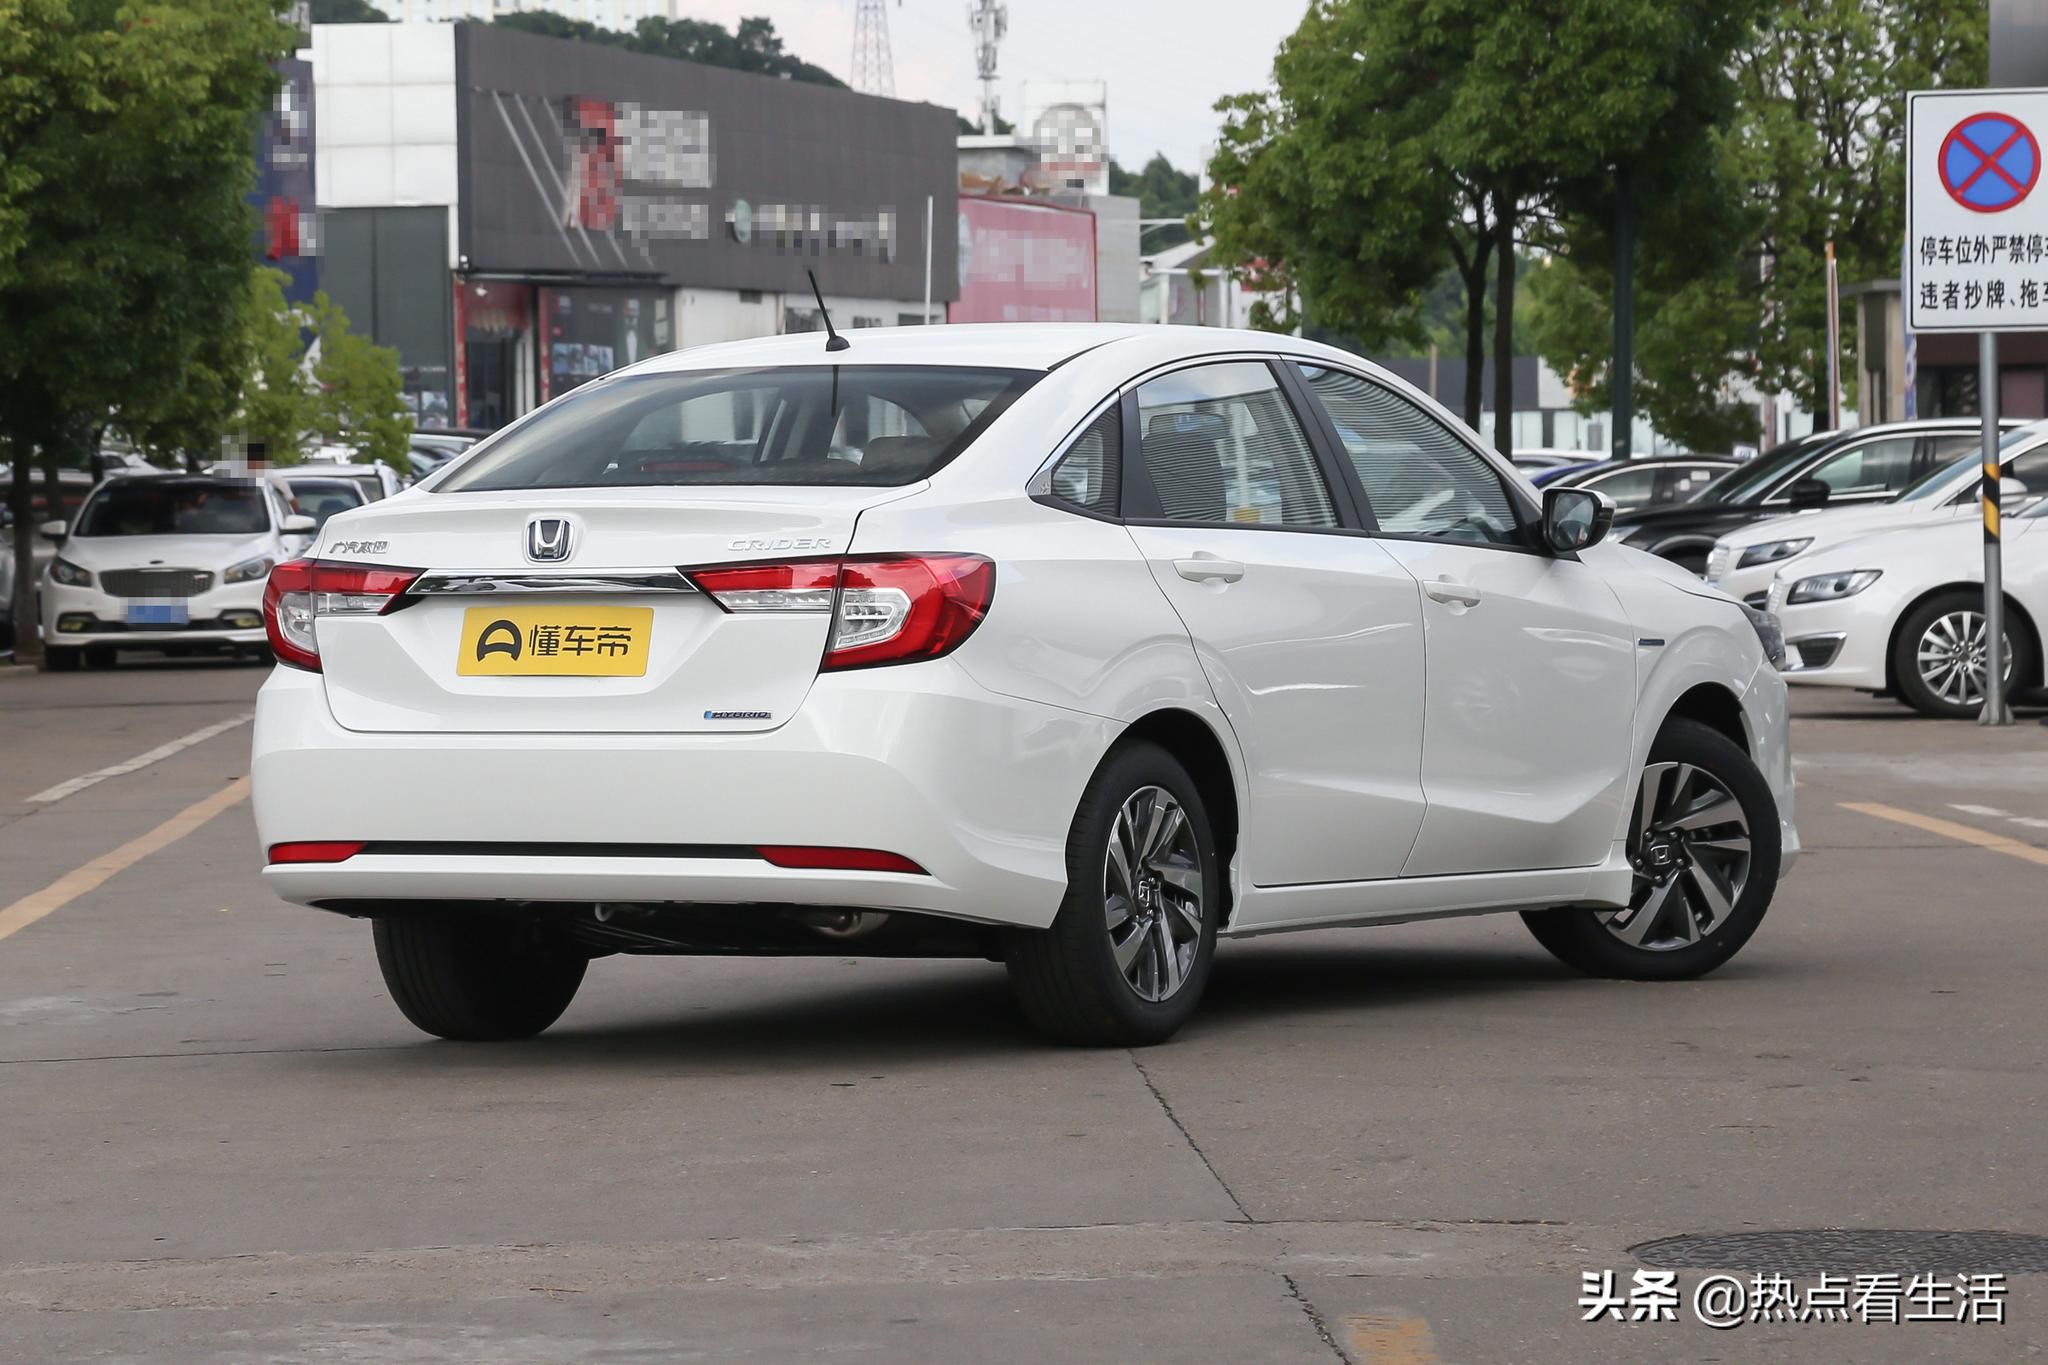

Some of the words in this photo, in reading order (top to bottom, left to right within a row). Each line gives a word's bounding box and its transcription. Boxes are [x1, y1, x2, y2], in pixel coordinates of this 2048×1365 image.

[1920, 234, 2048, 266] 停车位外严禁停
[728, 538, 832, 551] CRIDER
[528, 624, 632, 657] 懂车帝
